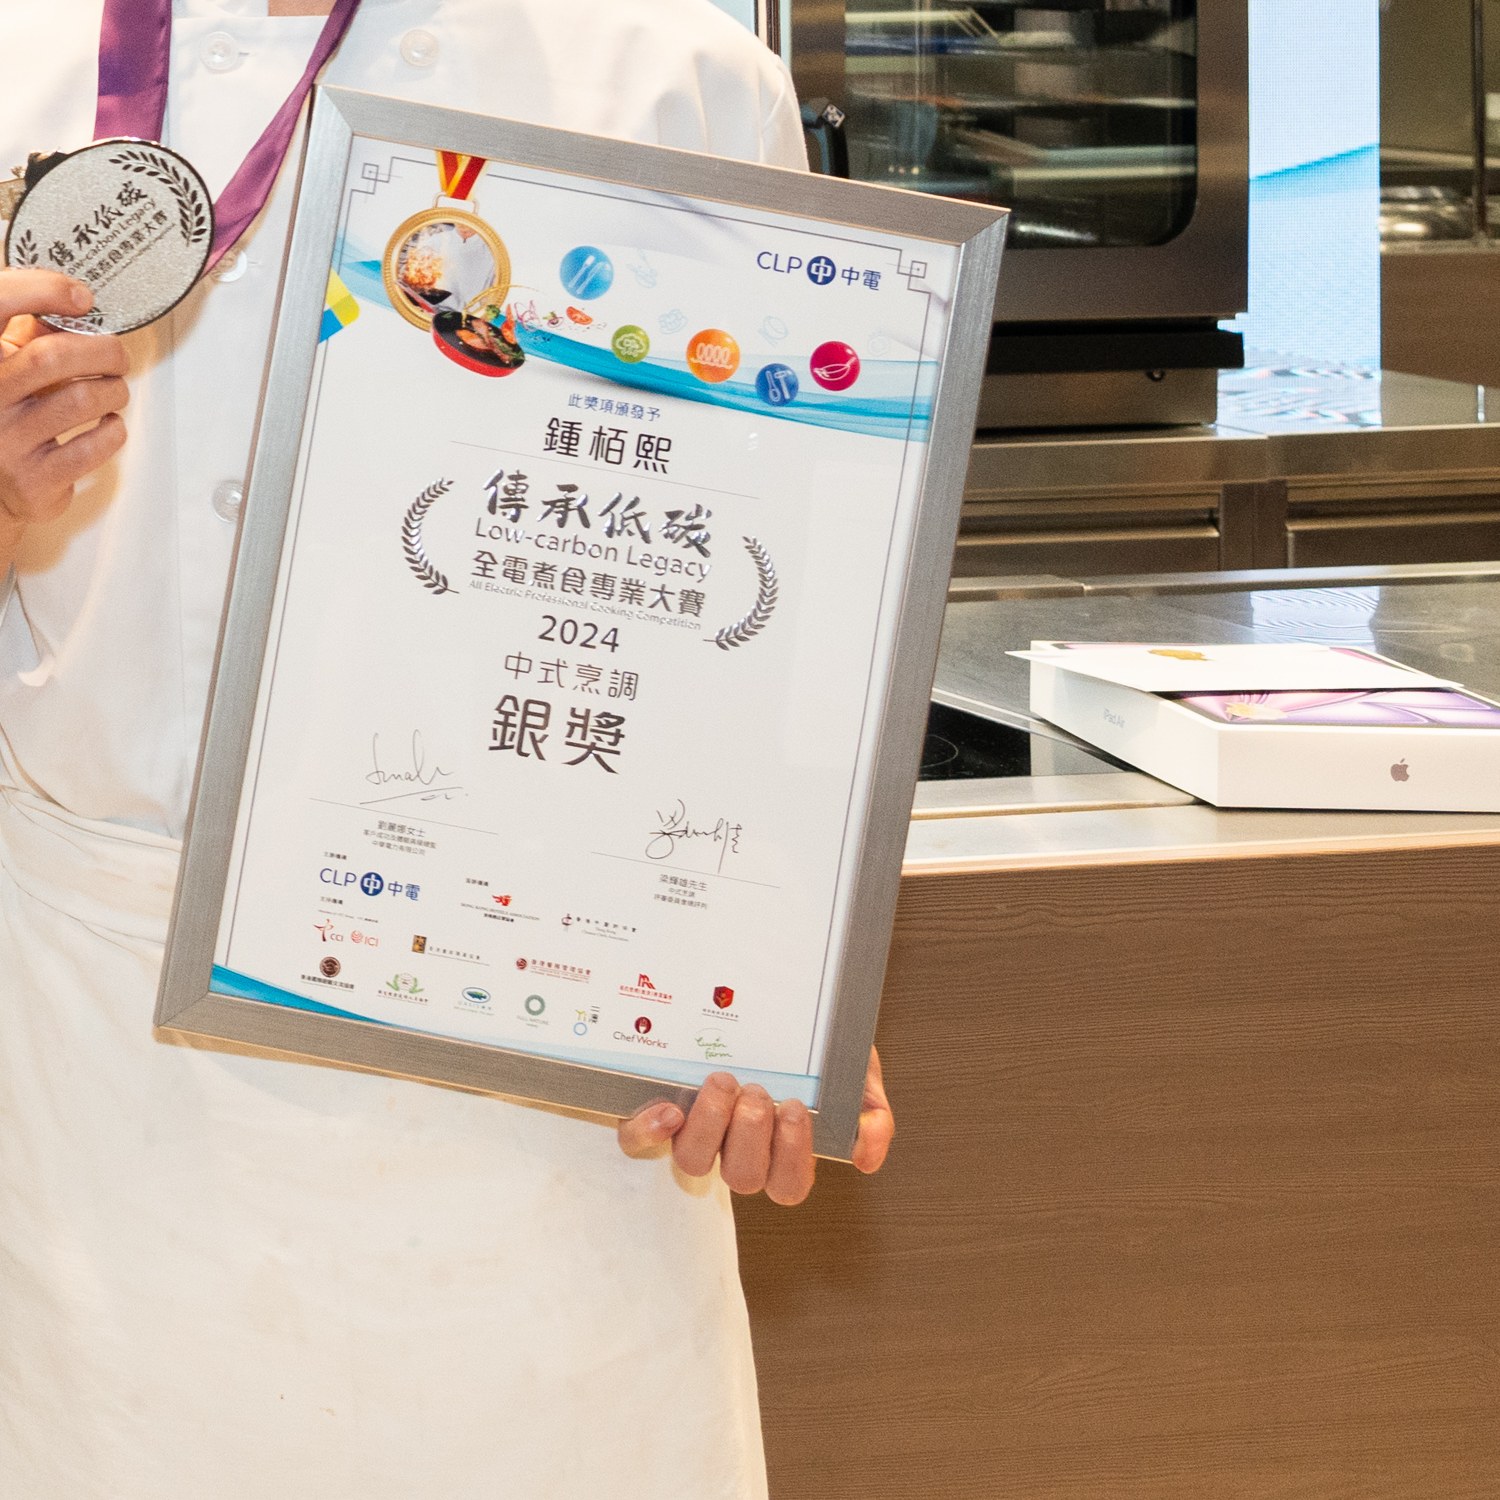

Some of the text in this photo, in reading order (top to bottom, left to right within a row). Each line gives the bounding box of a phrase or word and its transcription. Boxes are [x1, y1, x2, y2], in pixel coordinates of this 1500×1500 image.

[68, 229, 120, 276] ow-carbon
[84, 209, 168, 283] 電煮食專業大賽
[757, 251, 882, 291] CLP 中電
[568, 393, 661, 422] 此獎項頒發予
[482, 468, 713, 558] 傳承低碳
[475, 517, 712, 583] Low-carbon Legacy
[469, 579, 702, 631] All Electric Professional Cooking Competition
[471, 550, 706, 618] 全電煮食專業大賽
[538, 615, 620, 653] 2024
[504, 651, 639, 701] 中式烹調
[488, 694, 626, 775] 銀獎
[319, 867, 421, 902] CLP 中電
[364, 936, 379, 947] ICI
